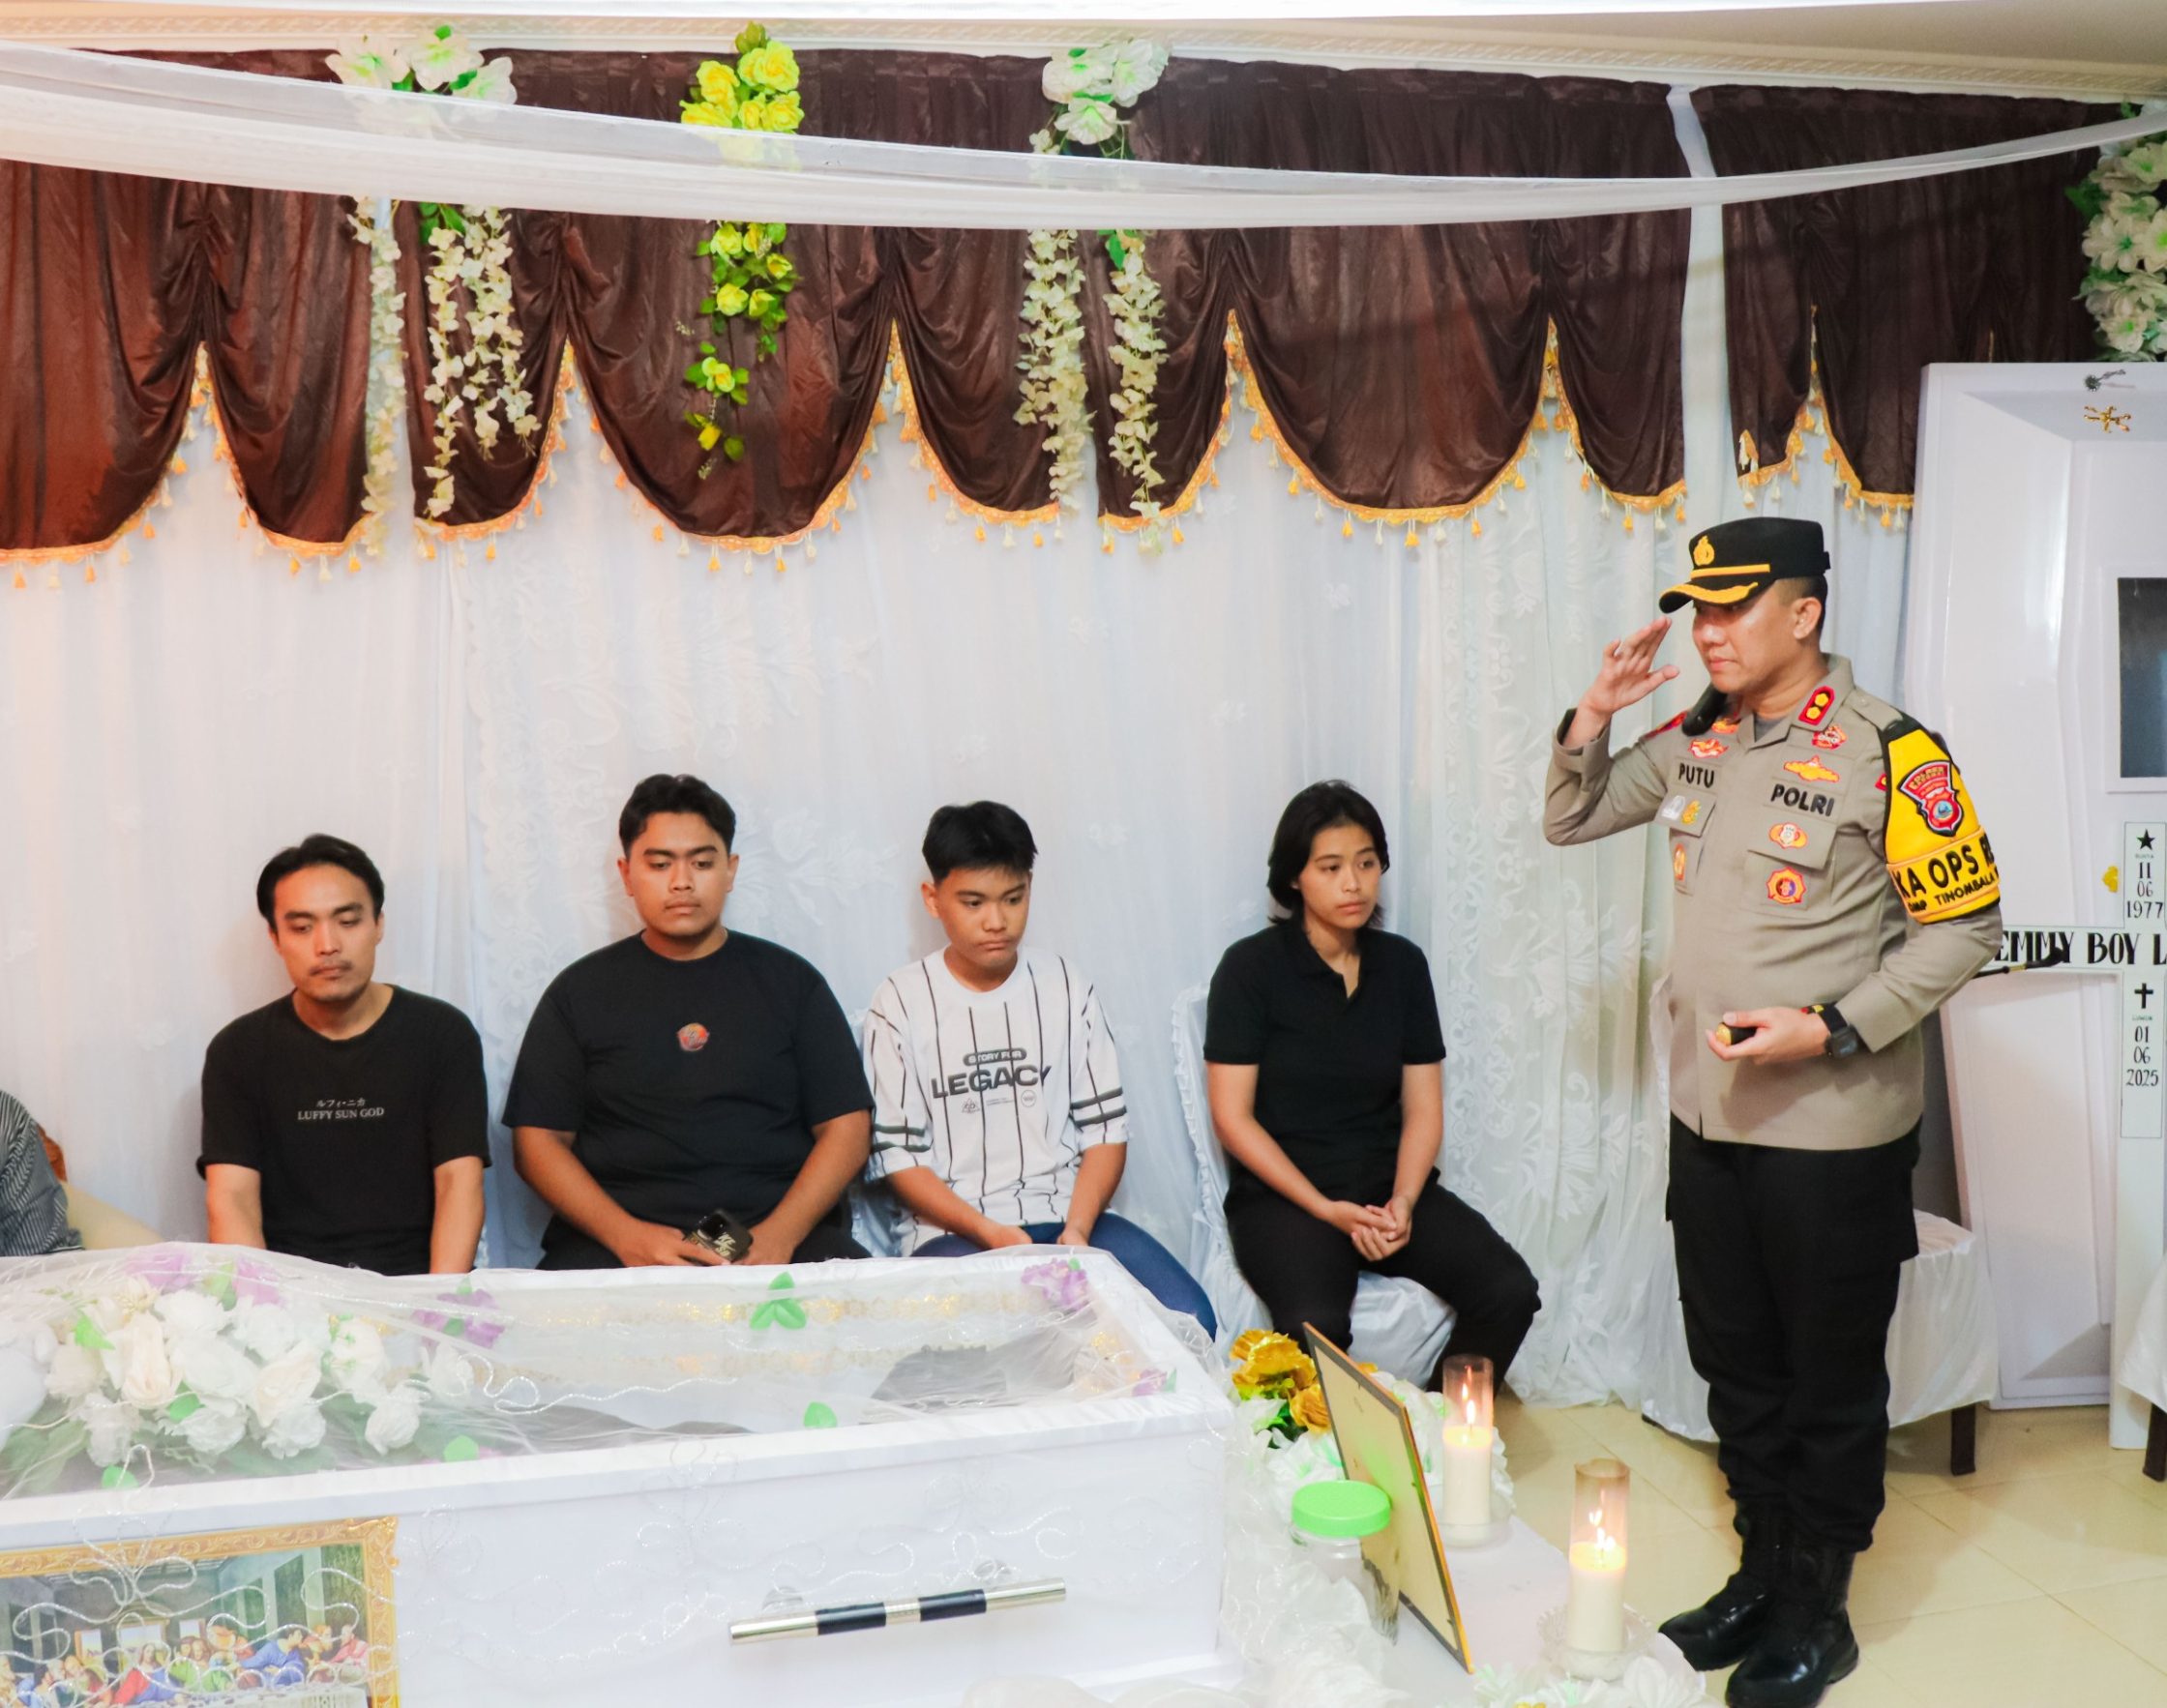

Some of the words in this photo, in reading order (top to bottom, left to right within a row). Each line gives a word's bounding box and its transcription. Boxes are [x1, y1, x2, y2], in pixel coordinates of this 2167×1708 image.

[1678, 762, 1715, 788] PUTU
[1770, 782, 1835, 817] POLRI
[1928, 843, 1979, 889] OPS
[2139, 862, 2152, 879] 11
[2137, 880, 2153, 898] 06
[2126, 900, 2164, 919] 1977
[2087, 931, 2141, 965] BOY
[2134, 1025, 2150, 1043] 01
[968, 1051, 999, 1064] STORY
[2133, 1045, 2151, 1064] 06
[931, 1064, 1053, 1099] LEGACY
[2125, 1069, 2159, 1087] 2025
[297, 1109, 334, 1121] LUFFY
[335, 1108, 358, 1120] SUN
[359, 1106, 385, 1118] GOD
